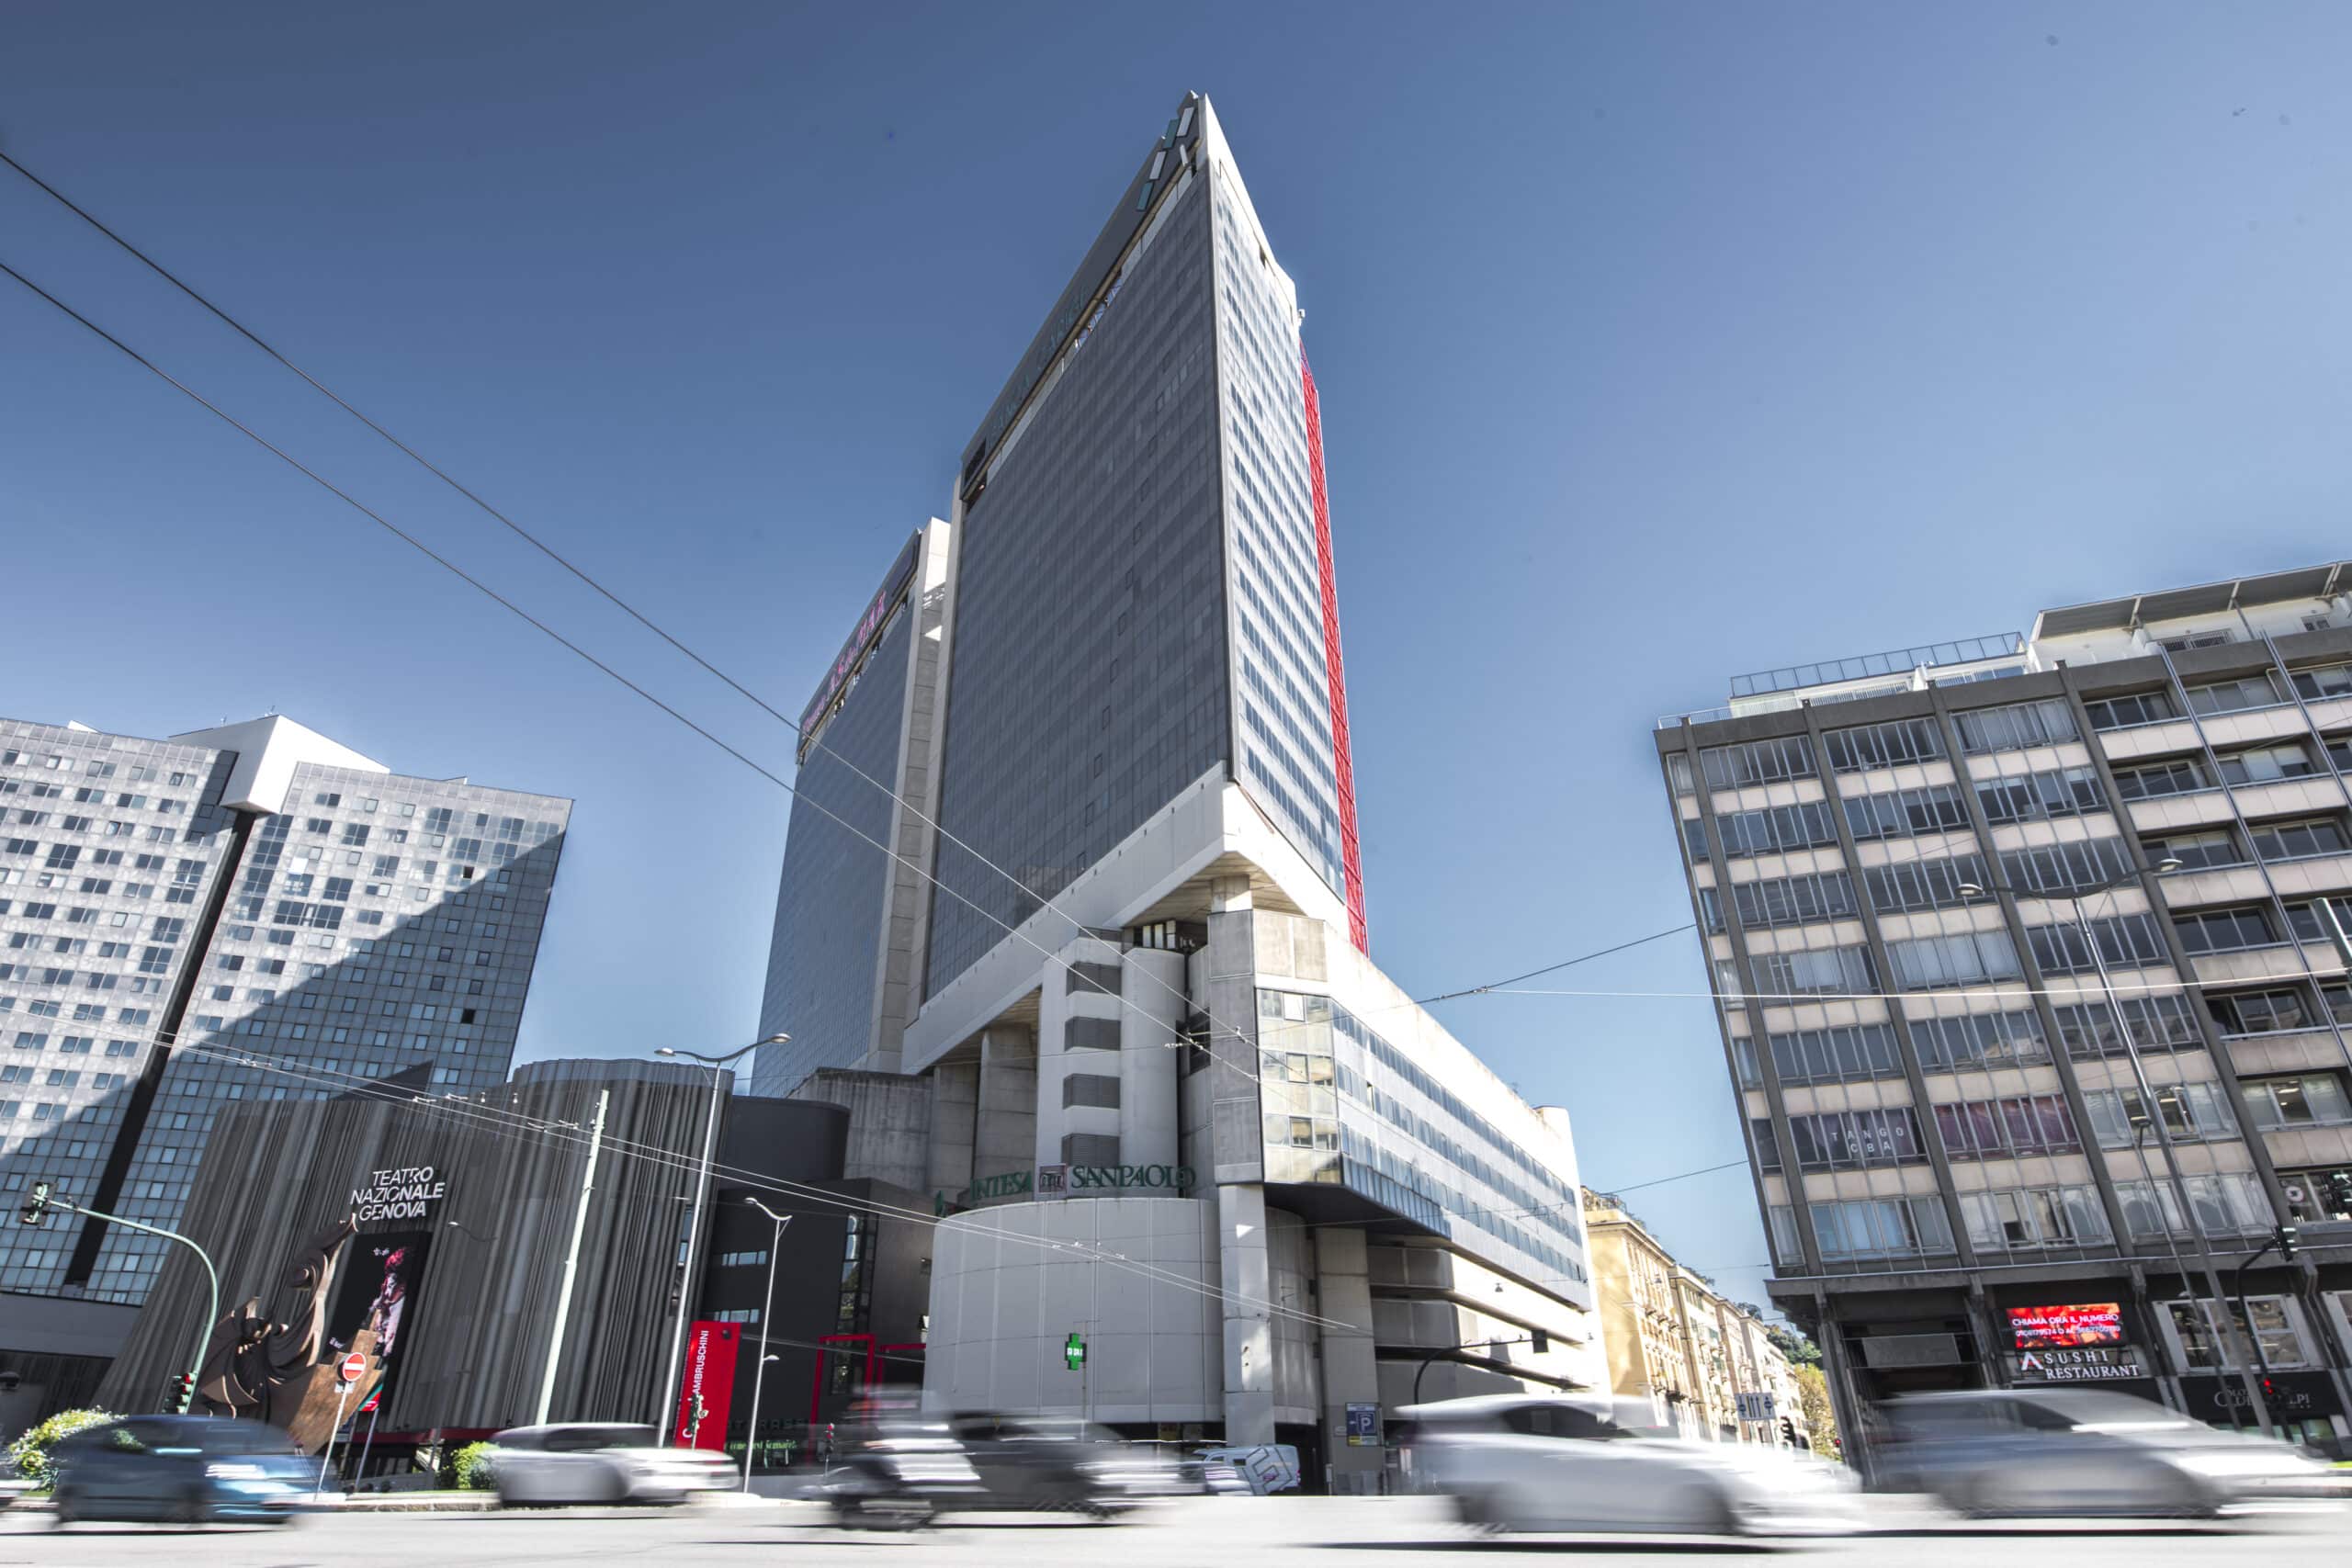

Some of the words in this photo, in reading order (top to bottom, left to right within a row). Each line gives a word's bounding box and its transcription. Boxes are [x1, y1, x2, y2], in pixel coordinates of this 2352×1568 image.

[1831, 1127, 1904, 1142] TANGO
[1850, 1141, 1892, 1153] CBA
[372, 1167, 434, 1187] TEATRO
[970, 1171, 1033, 1200] INTESA
[1070, 1165, 1196, 1189] SANPAOLO
[350, 1182, 446, 1205] NAZIONALE
[359, 1201, 426, 1221] GENOVA
[2012, 1315, 2048, 1326] CHIAMA
[2048, 1315, 2067, 1325] ORA
[2079, 1314, 2119, 1324] NUMERO
[2043, 1350, 2109, 1364] SUSHI
[2045, 1364, 2139, 1380] RESTAURANT
